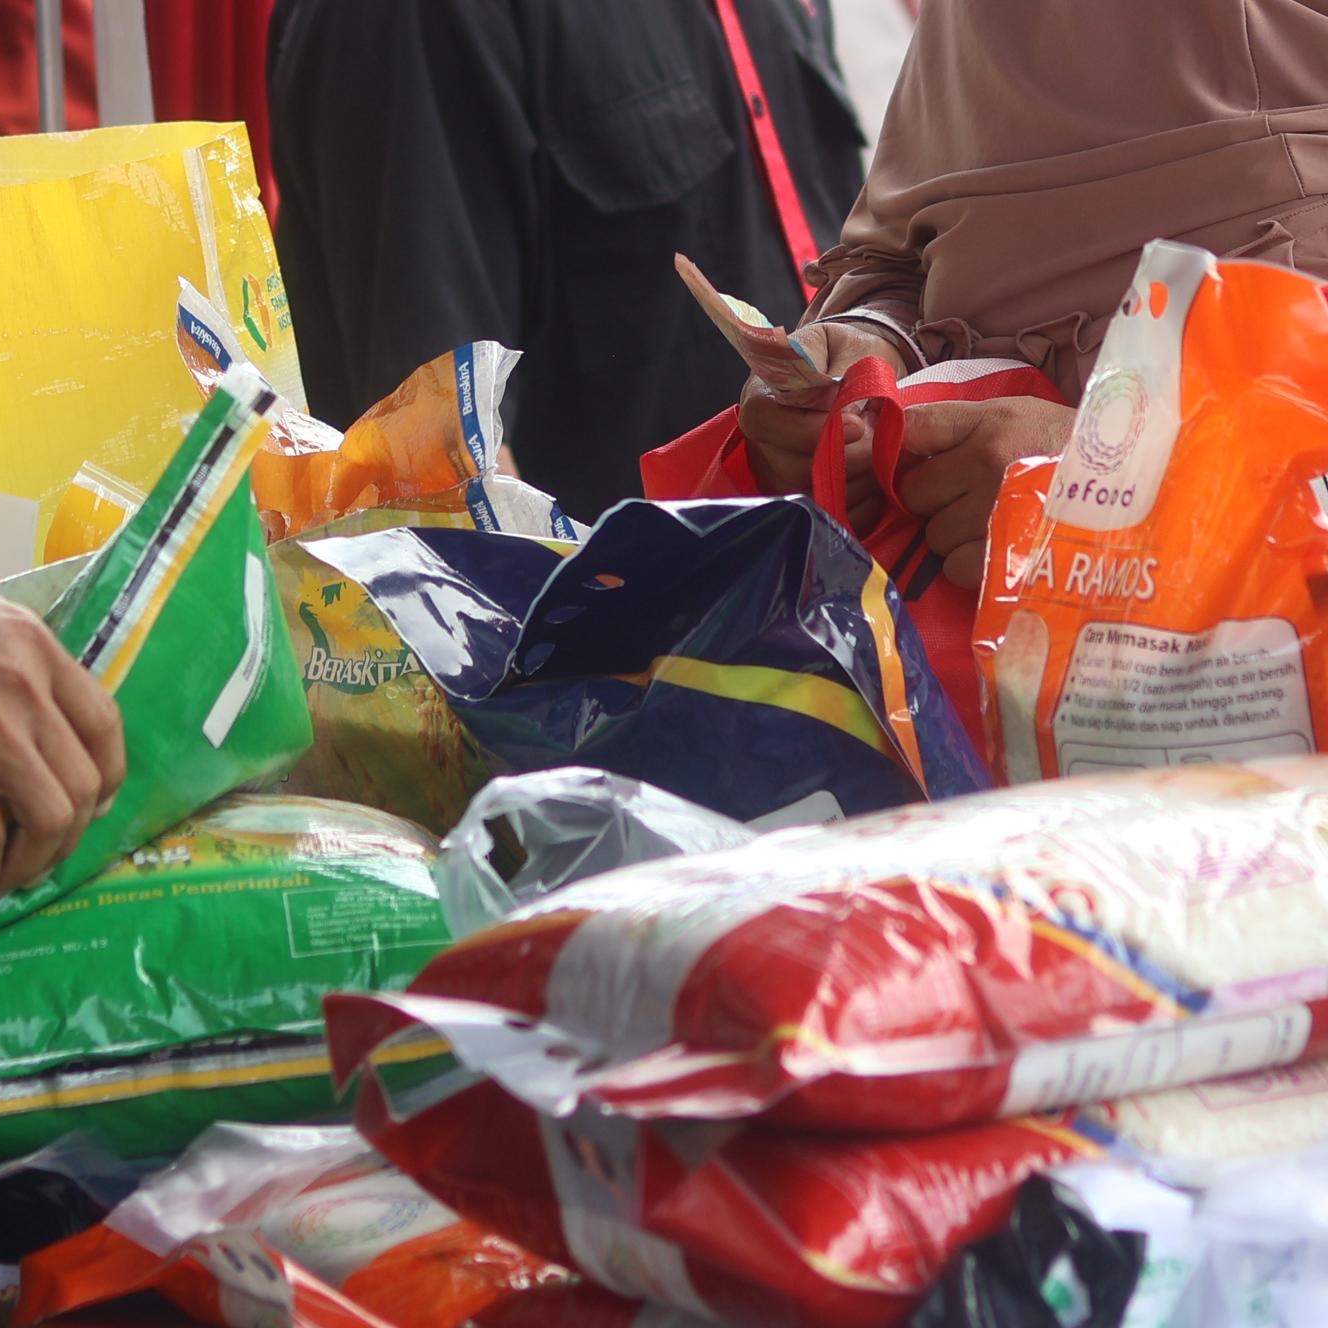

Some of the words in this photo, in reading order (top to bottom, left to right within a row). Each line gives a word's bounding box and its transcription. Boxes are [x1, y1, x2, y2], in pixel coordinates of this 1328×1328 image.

[1065, 551, 1158, 602] RAMOS
[97, 886, 165, 907] Beras
[172, 872, 312, 897] Pemerintah
